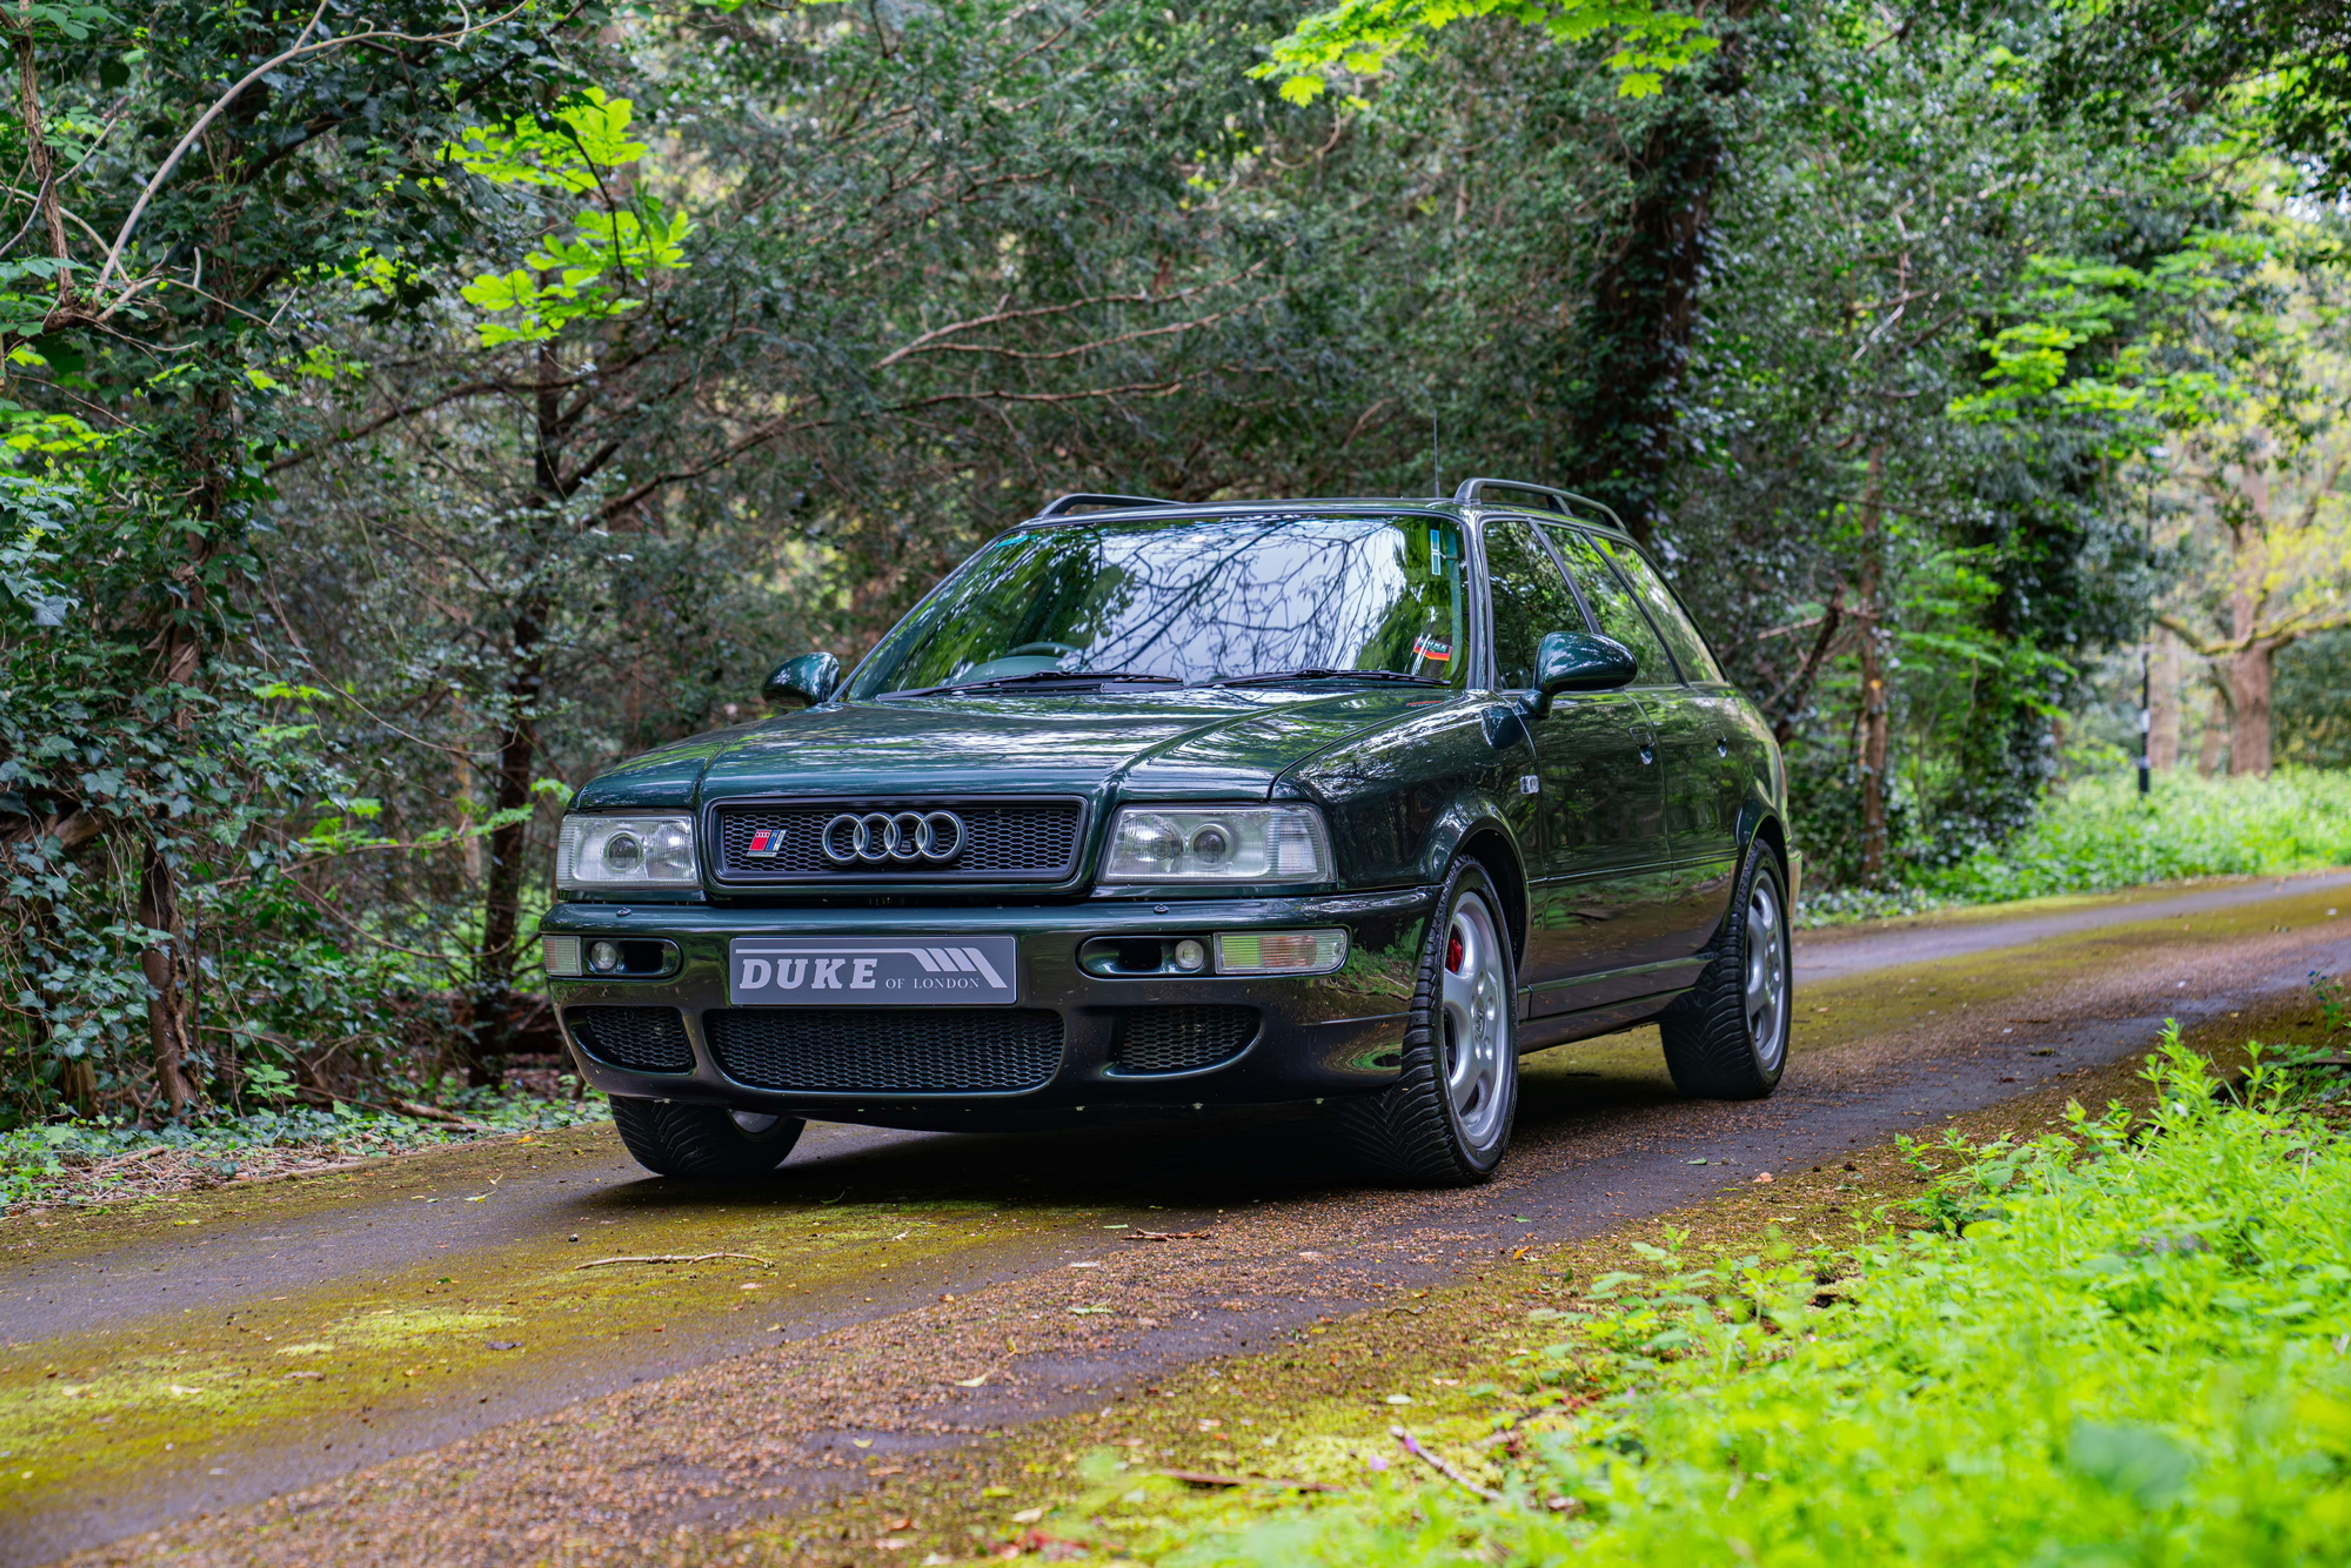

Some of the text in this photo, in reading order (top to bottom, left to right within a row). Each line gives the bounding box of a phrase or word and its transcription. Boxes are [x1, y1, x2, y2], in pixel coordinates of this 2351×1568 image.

[739, 959, 980, 989] DUKE OF LONDON
